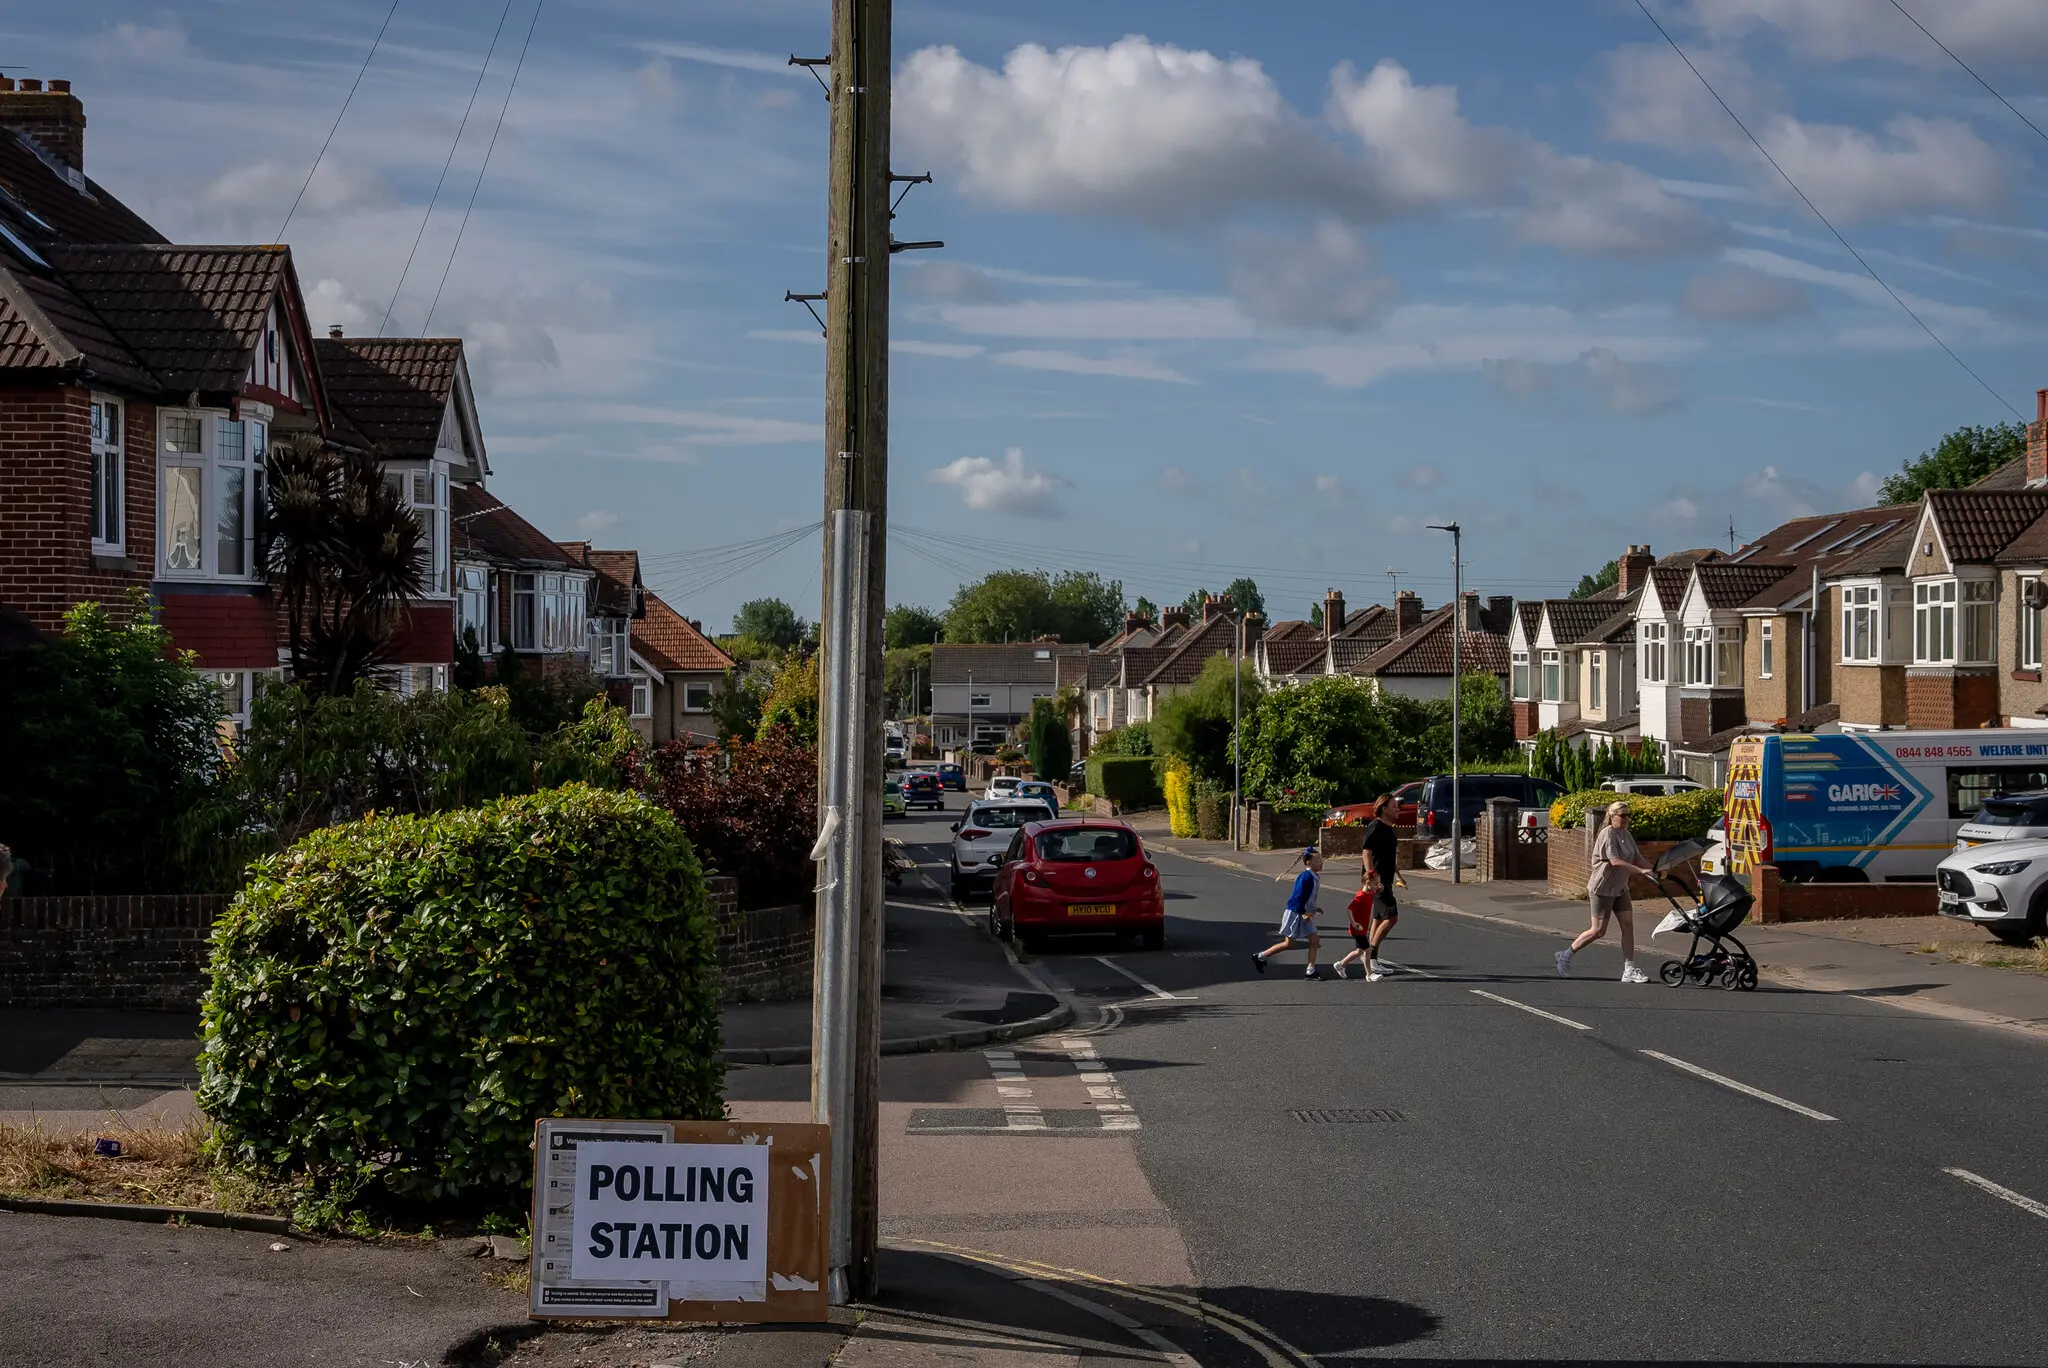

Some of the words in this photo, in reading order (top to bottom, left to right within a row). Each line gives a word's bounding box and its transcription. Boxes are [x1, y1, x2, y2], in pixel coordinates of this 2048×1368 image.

[1896, 747, 1921, 758] 0844
[1924, 746, 1944, 757] 848
[1946, 745, 1972, 757] 4565
[1979, 745, 2024, 756] WELFARE
[1828, 783, 1884, 802] GARIC
[1073, 905, 1092, 914] HY10
[589, 1164, 754, 1203] POLLING
[588, 1222, 749, 1261] STATION
